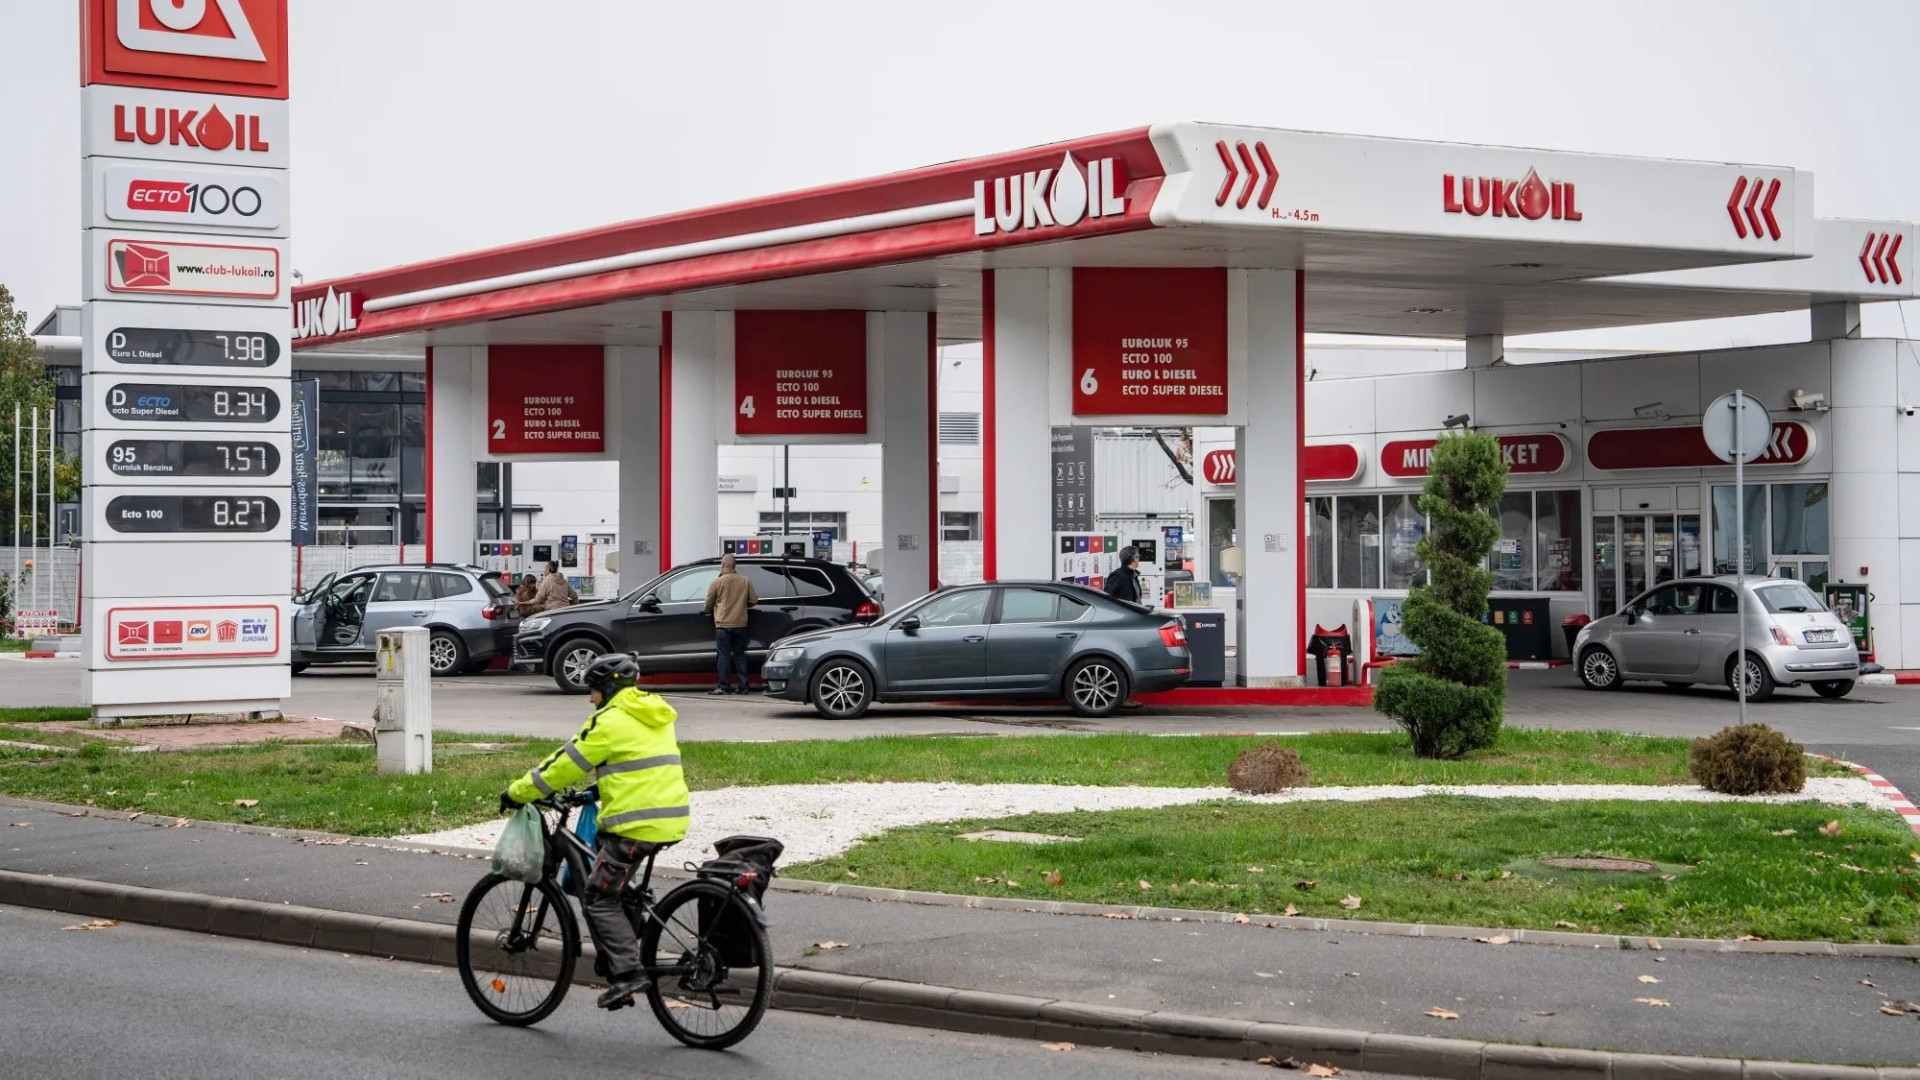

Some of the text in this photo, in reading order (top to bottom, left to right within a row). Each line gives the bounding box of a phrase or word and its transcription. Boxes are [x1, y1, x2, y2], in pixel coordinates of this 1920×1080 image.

[114, 103, 269, 152] LUKOIL
[974, 150, 1125, 235] LUKOIL
[1443, 165, 1583, 221] LUKOIL
[176, 263, 275, 279] www.club-lukoil.ro
[112, 332, 127, 349] D
[216, 335, 265, 361] 7.98
[1121, 338, 1188, 348] EUROLUK 95
[139, 350, 162, 358] Diesel
[1122, 353, 1173, 364] ECTO 100
[776, 370, 833, 378] EUROLUK 95
[1080, 368, 1099, 396] 6
[1122, 369, 1197, 380] EURO L DIESEL
[776, 383, 819, 392] ECTO 100
[1122, 385, 1223, 396] ECTO SUPER DIESEL
[112, 389, 127, 406] D
[137, 396, 171, 407] ECTO
[214, 391, 266, 416] 8.34
[776, 396, 841, 405] EURO L DIESEL
[131, 407, 154, 416] Super
[155, 408, 179, 416] Diesel
[739, 395, 756, 418] 4
[776, 410, 863, 418] ECTO SUPER DIESEL
[492, 419, 506, 439] 2
[524, 431, 600, 439] ECTO SUPER DIESEL
[112, 446, 136, 463] 95
[216, 446, 266, 471] 7.57
[1402, 448, 1437, 469] MIN
[112, 463, 173, 472] Euroluk Benzina
[122, 509, 163, 519] Ecto 100
[214, 500, 265, 525] 8.27
